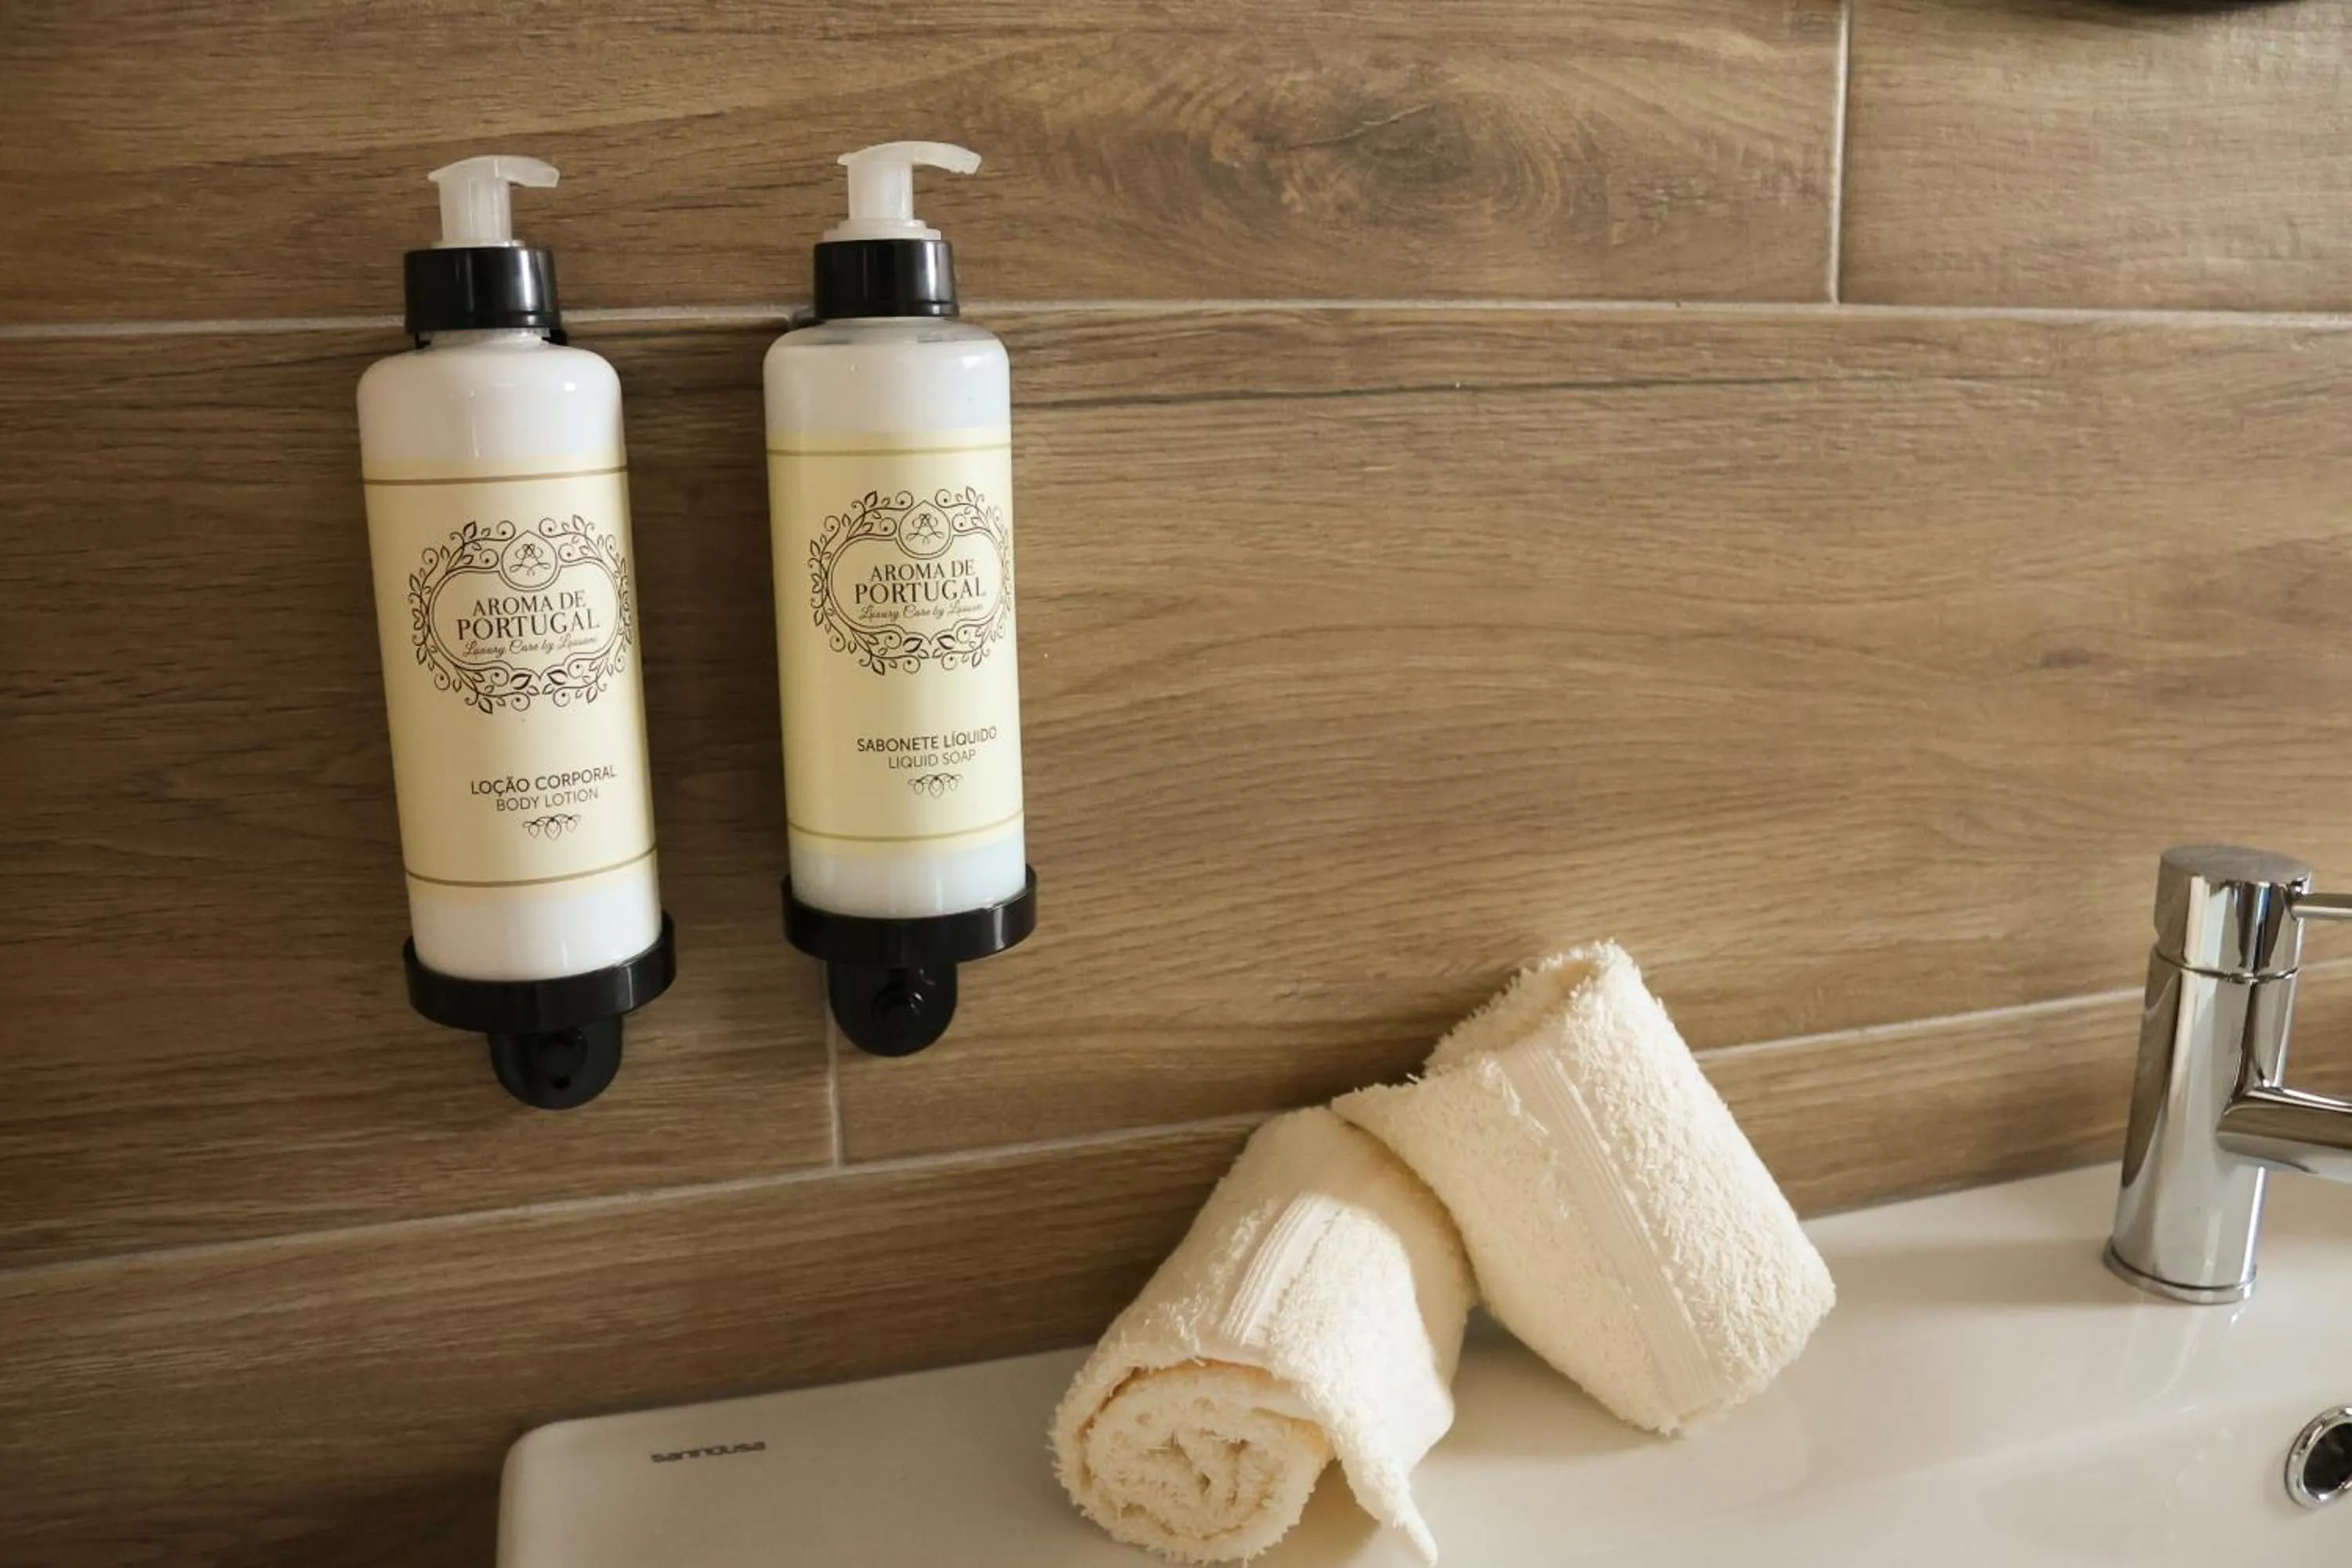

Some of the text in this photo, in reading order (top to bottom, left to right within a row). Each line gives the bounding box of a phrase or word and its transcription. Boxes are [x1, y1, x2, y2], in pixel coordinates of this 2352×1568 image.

[870, 559, 976, 583] AROMA DE
[472, 589, 588, 617] AROMA DE
[854, 577, 987, 604] PORTUGAL
[456, 608, 601, 641] PORTUGAL
[857, 726, 997, 753] SABONETE LÍQUIDO
[888, 749, 977, 769] LIQUID SOAP
[470, 764, 618, 797] LOÇÃO CORPORAL
[496, 787, 599, 811] BODY LOTION
